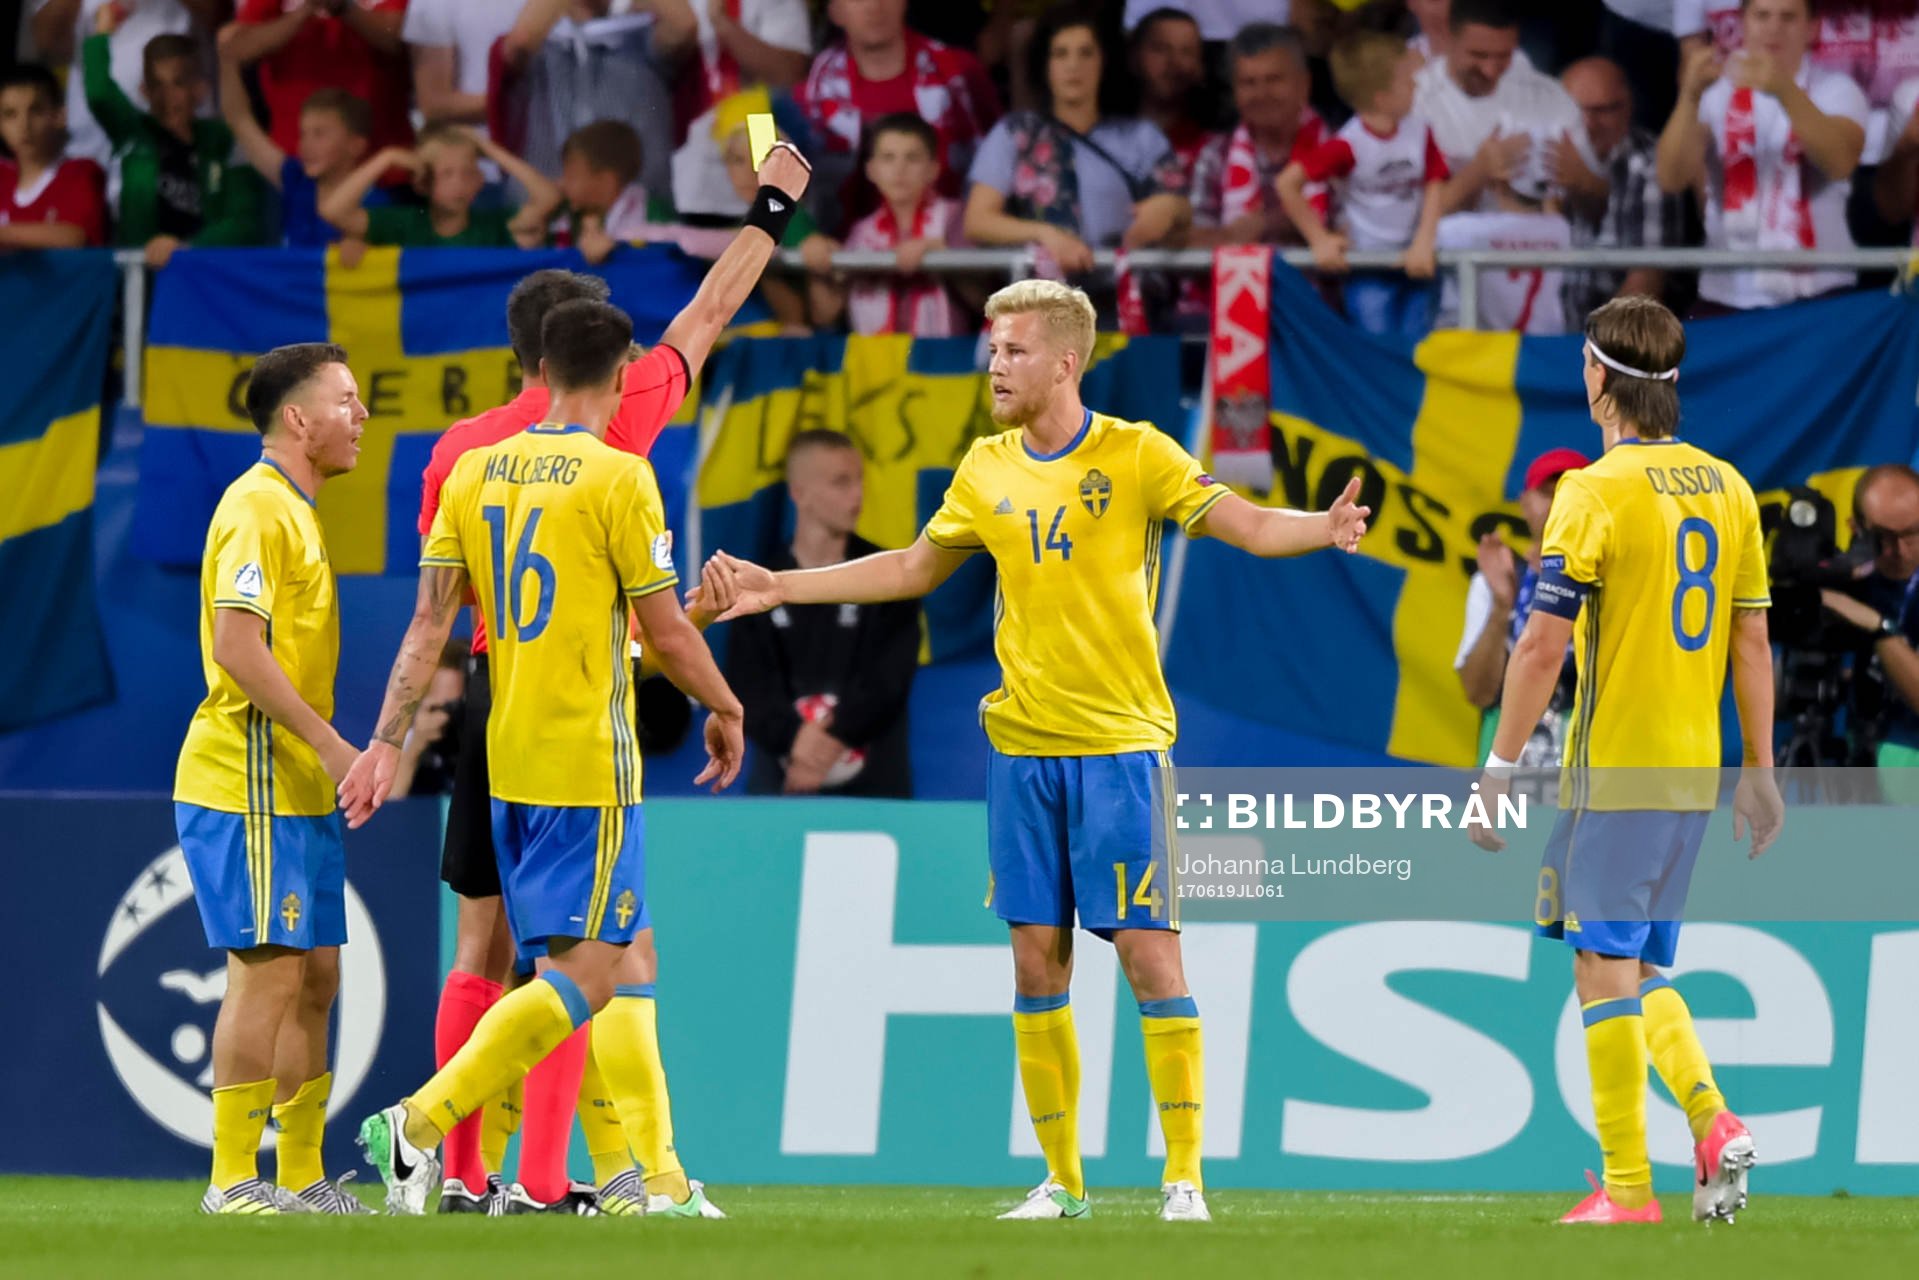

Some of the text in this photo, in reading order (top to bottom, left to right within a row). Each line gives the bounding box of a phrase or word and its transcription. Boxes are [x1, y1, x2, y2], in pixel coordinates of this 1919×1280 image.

[483, 453, 583, 486] HALLBERG
[1645, 465, 1726, 497] OLSSON
[1026, 504, 1073, 564] 14
[482, 504, 557, 643] 16
[1671, 517, 1719, 652] 8
[1113, 861, 1164, 920] 14
[1535, 866, 1560, 928] 8
[779, 831, 1919, 1165] Hise
